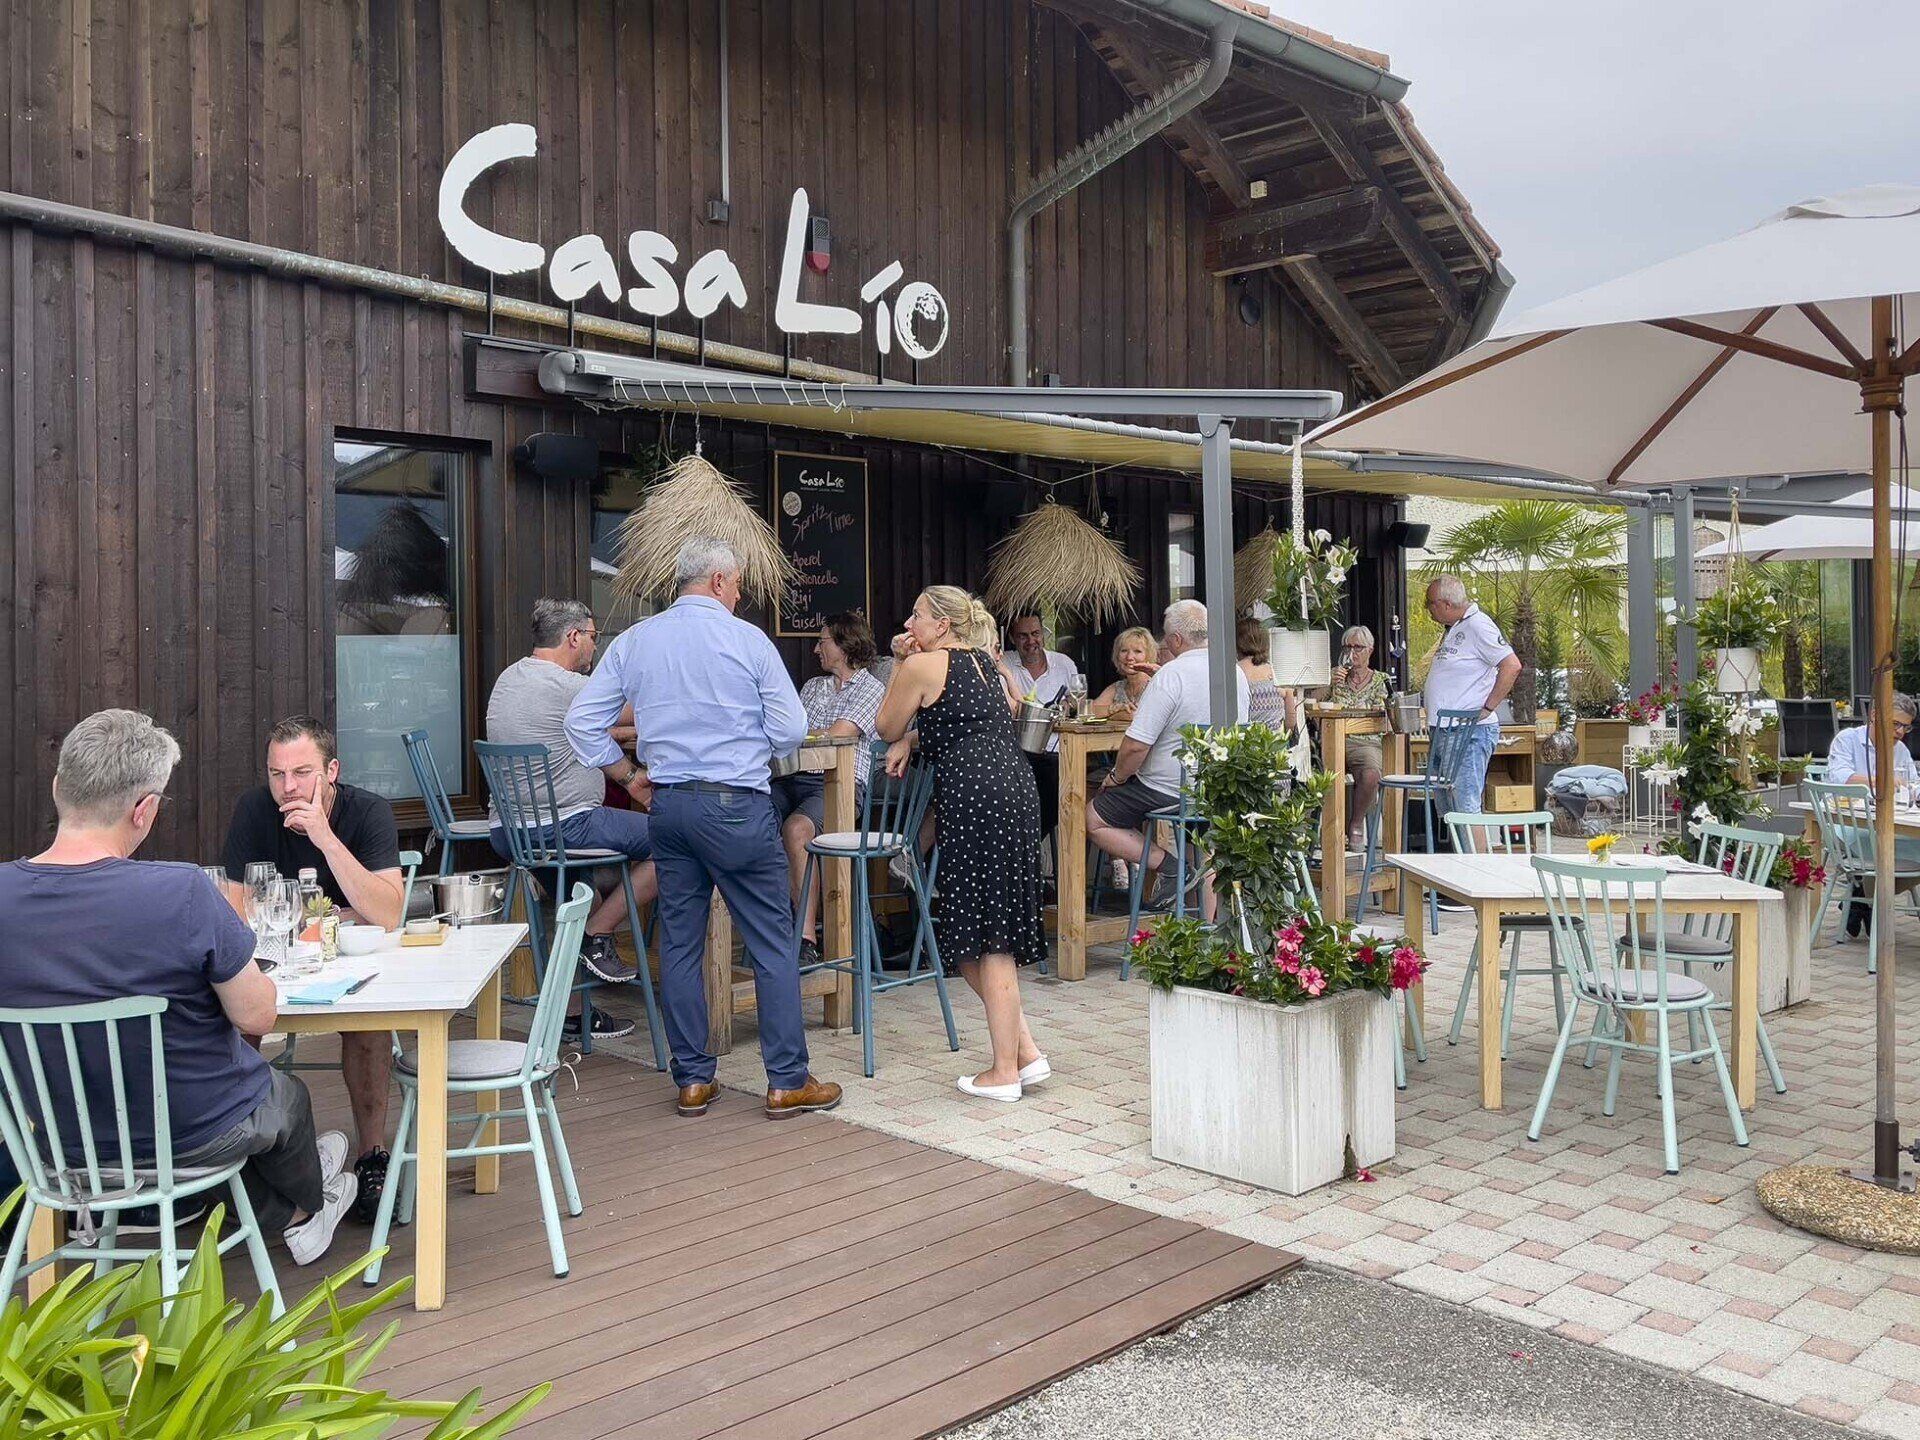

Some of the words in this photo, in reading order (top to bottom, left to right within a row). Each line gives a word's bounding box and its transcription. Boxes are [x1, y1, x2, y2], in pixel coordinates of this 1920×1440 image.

[438, 123, 748, 318] Casa
[799, 469, 825, 487] Casa
[791, 502, 828, 546] Spritz
[826, 510, 855, 533] Time
[791, 550, 823, 573] Aperol
[791, 570, 839, 587] Lmoncello
[791, 612, 827, 630] Giselle
